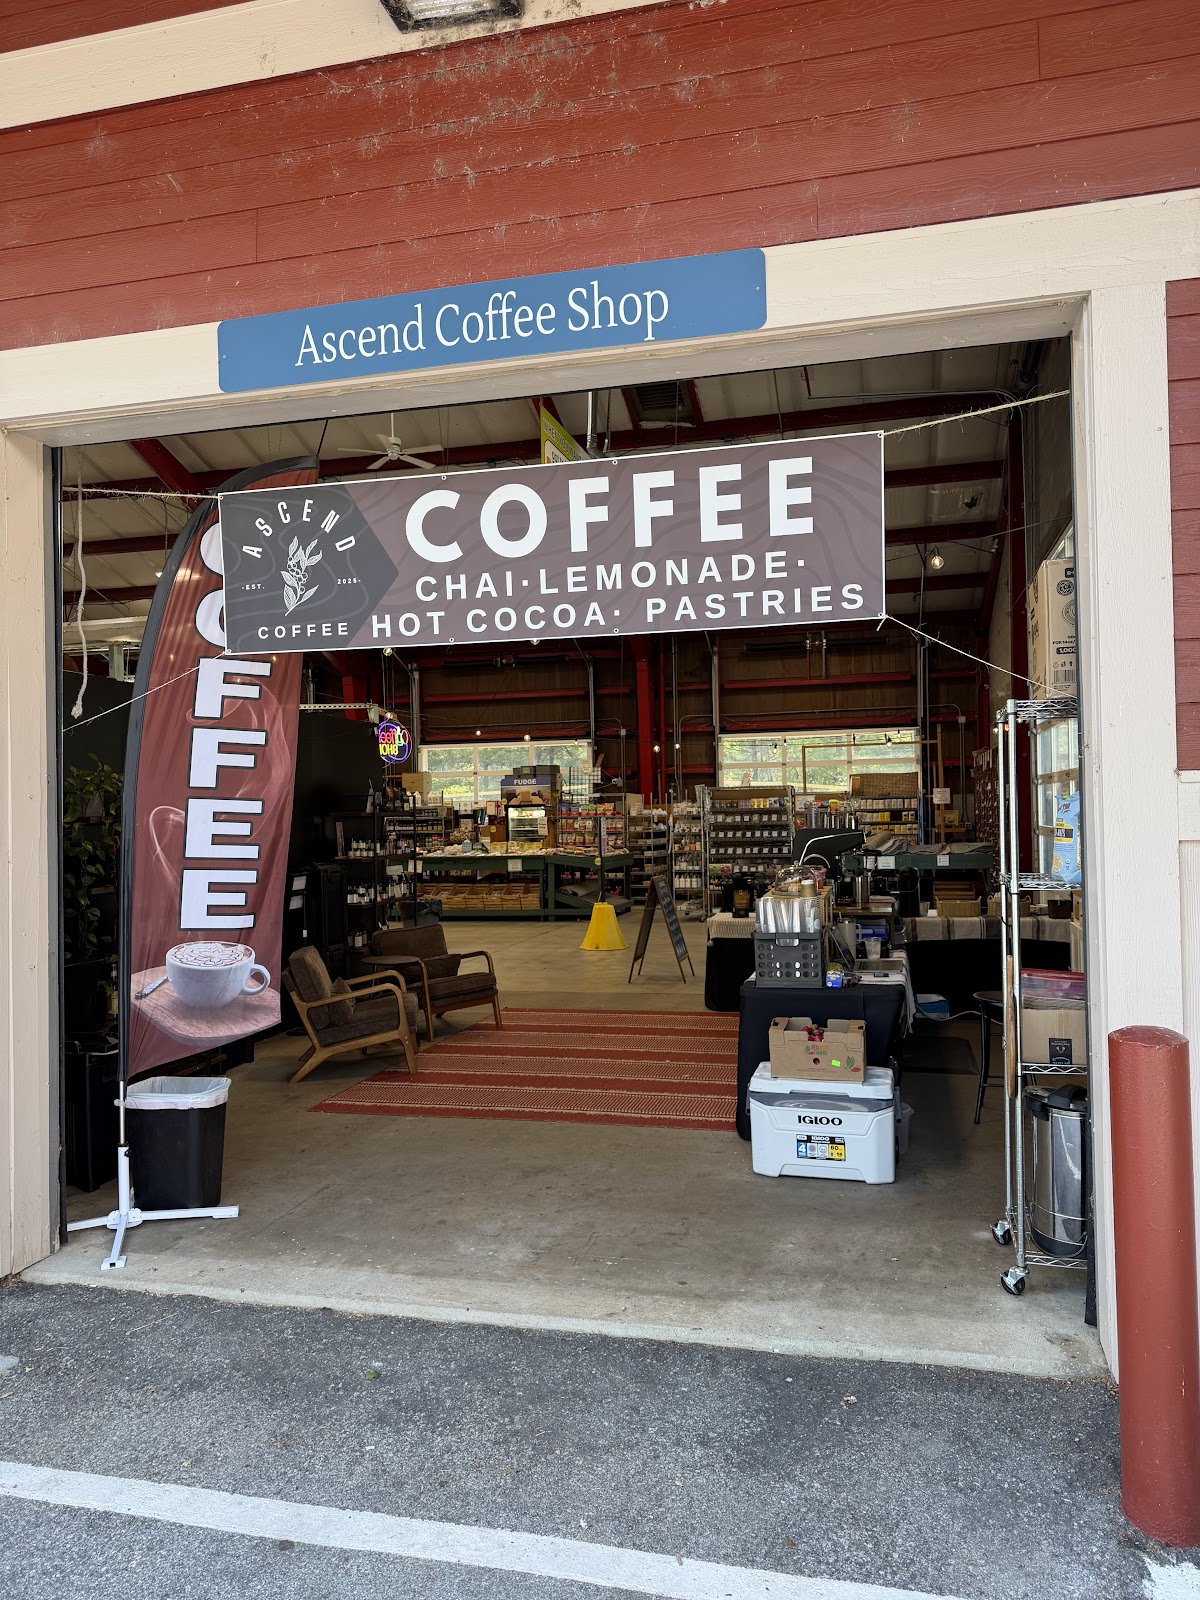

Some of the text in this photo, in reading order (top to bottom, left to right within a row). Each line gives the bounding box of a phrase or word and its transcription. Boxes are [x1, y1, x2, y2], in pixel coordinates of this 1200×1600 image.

[295, 280, 669, 367] Ascend Coffee Shop
[242, 499, 356, 559] ASCEND
[405, 456, 814, 563] COFFEE
[258, 622, 348, 640] COFFEE
[372, 611, 445, 638] HOT
[646, 583, 864, 623] PASTRIES
[798, 1115, 842, 1126] IGLOO
